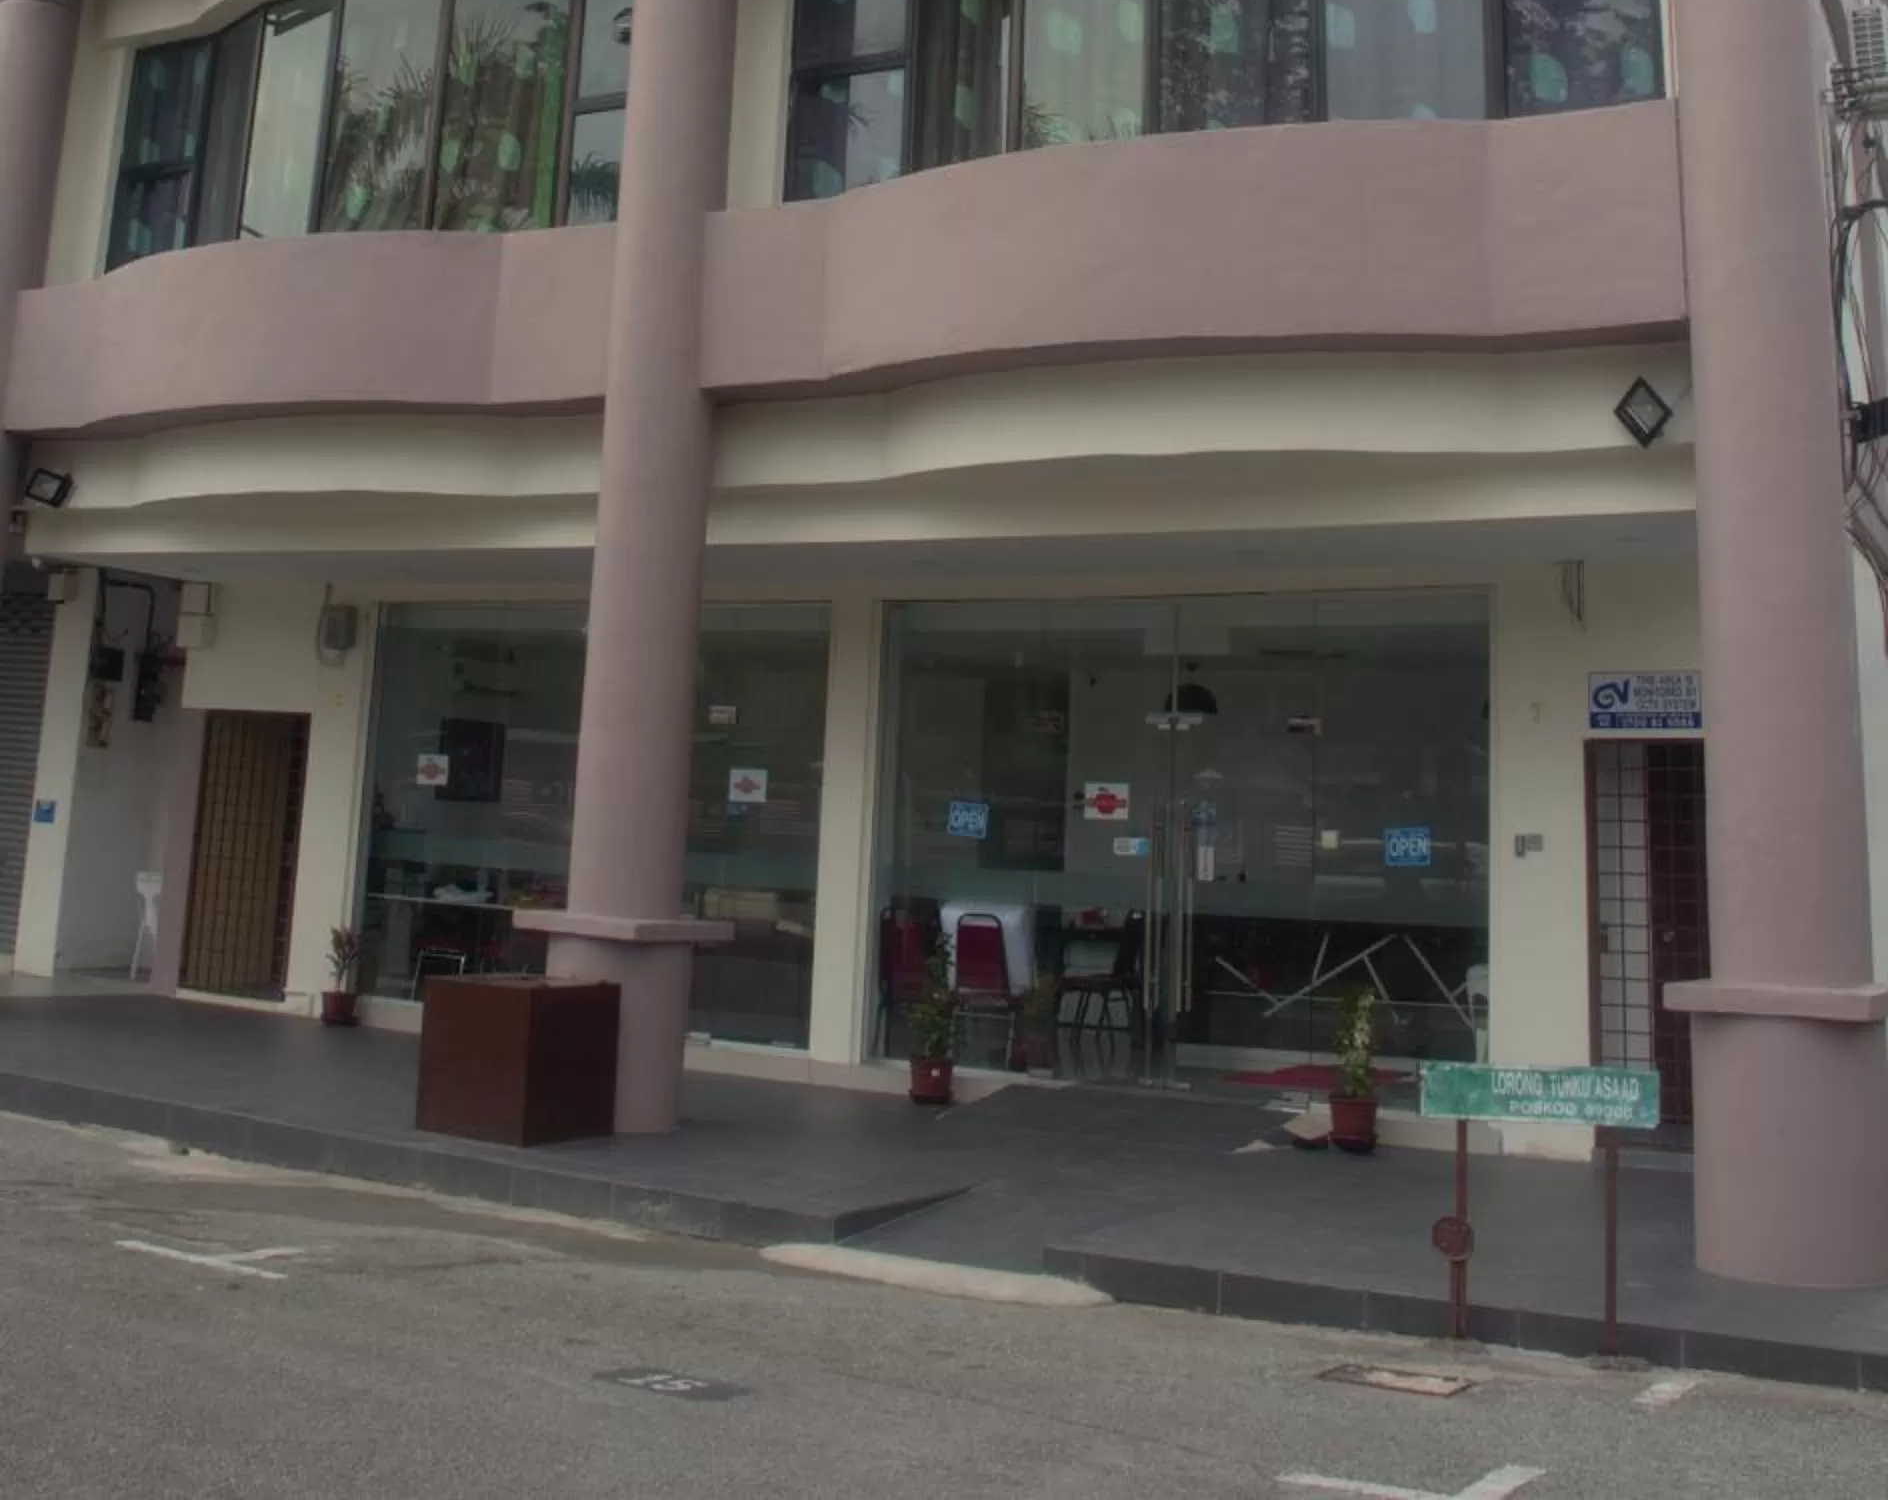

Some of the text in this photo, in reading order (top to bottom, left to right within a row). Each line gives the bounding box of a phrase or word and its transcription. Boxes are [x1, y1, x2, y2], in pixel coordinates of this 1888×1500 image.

[951, 810, 986, 829] OPEN
[1389, 837, 1427, 856] OPEN
[1491, 1070, 1543, 1097] LORONG
